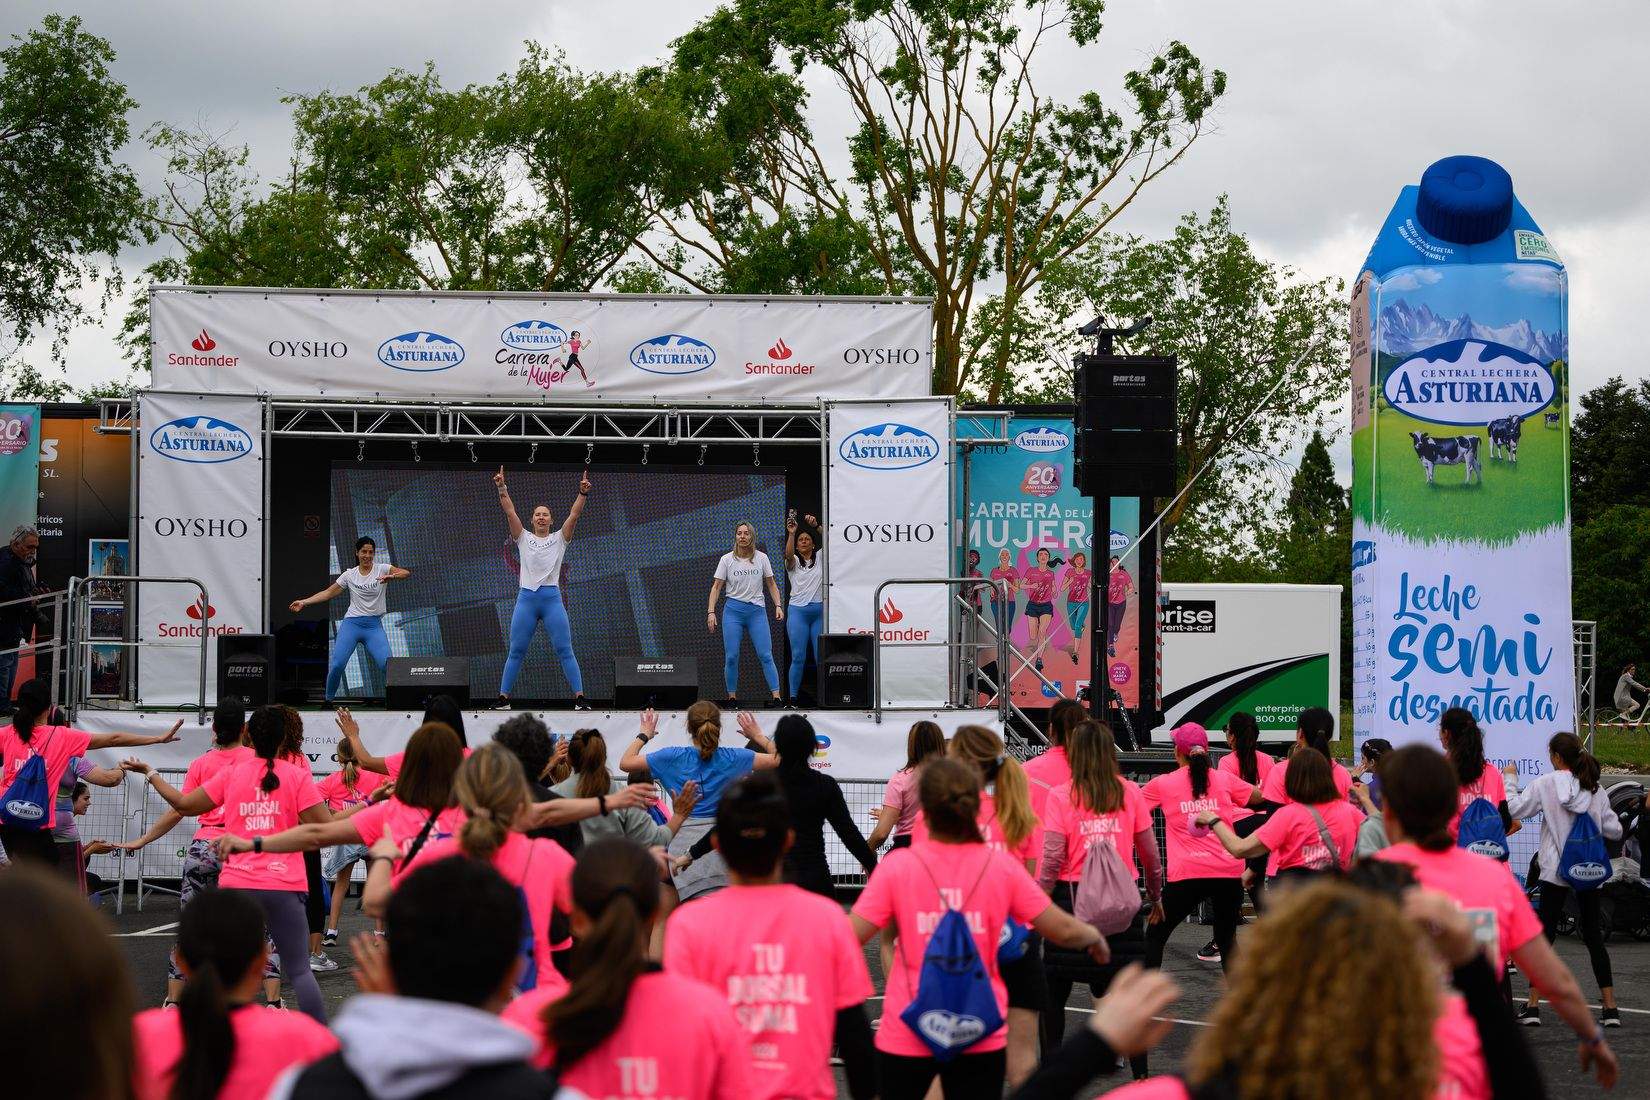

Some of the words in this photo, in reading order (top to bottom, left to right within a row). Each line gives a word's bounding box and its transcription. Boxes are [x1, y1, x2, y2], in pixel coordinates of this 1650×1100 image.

[1519, 236, 1547, 248] CERO
[505, 331, 562, 343] ASTURIANA
[268, 340, 348, 359] OYSHO
[384, 345, 458, 362] ASTURIANA
[495, 348, 550, 365] Carrera
[636, 348, 710, 365] ASTURIANA
[843, 347, 920, 365] OYSHO
[168, 353, 239, 367] Santander
[745, 362, 815, 375] Santander
[508, 365, 518, 377] de
[520, 365, 528, 377] la
[526, 363, 570, 389] Mujer
[1421, 369, 1477, 378] CENTRAL
[1481, 369, 1538, 378] LECHERA
[1392, 371, 1544, 404] ASTURIANA
[158, 431, 245, 452] ASTURIANA
[846, 440, 932, 459] ASTURIANA
[1019, 437, 1066, 447] ASTURIANA
[1028, 466, 1055, 485] 20
[1065, 510, 1078, 518] DE
[154, 517, 248, 538] OYSHO
[843, 523, 935, 544] OYSHO
[956, 519, 1086, 548] MUJER
[733, 569, 759, 577] OYSHO
[1393, 572, 1481, 626] Leche
[1161, 624, 1213, 632] rent-a-car
[1388, 613, 1553, 682] semi
[1255, 704, 1306, 714] enterprise
[239, 801, 281, 816] DORSAL
[1180, 798, 1220, 814] DORSAL
[245, 816, 275, 831] SUMA
[1079, 818, 1121, 835] DORSAL
[940, 887, 964, 911] TU
[753, 943, 785, 973] TU
[727, 973, 810, 1005] DORSAL
[736, 1003, 798, 1034] SUMA
[616, 1056, 660, 1096] TU
